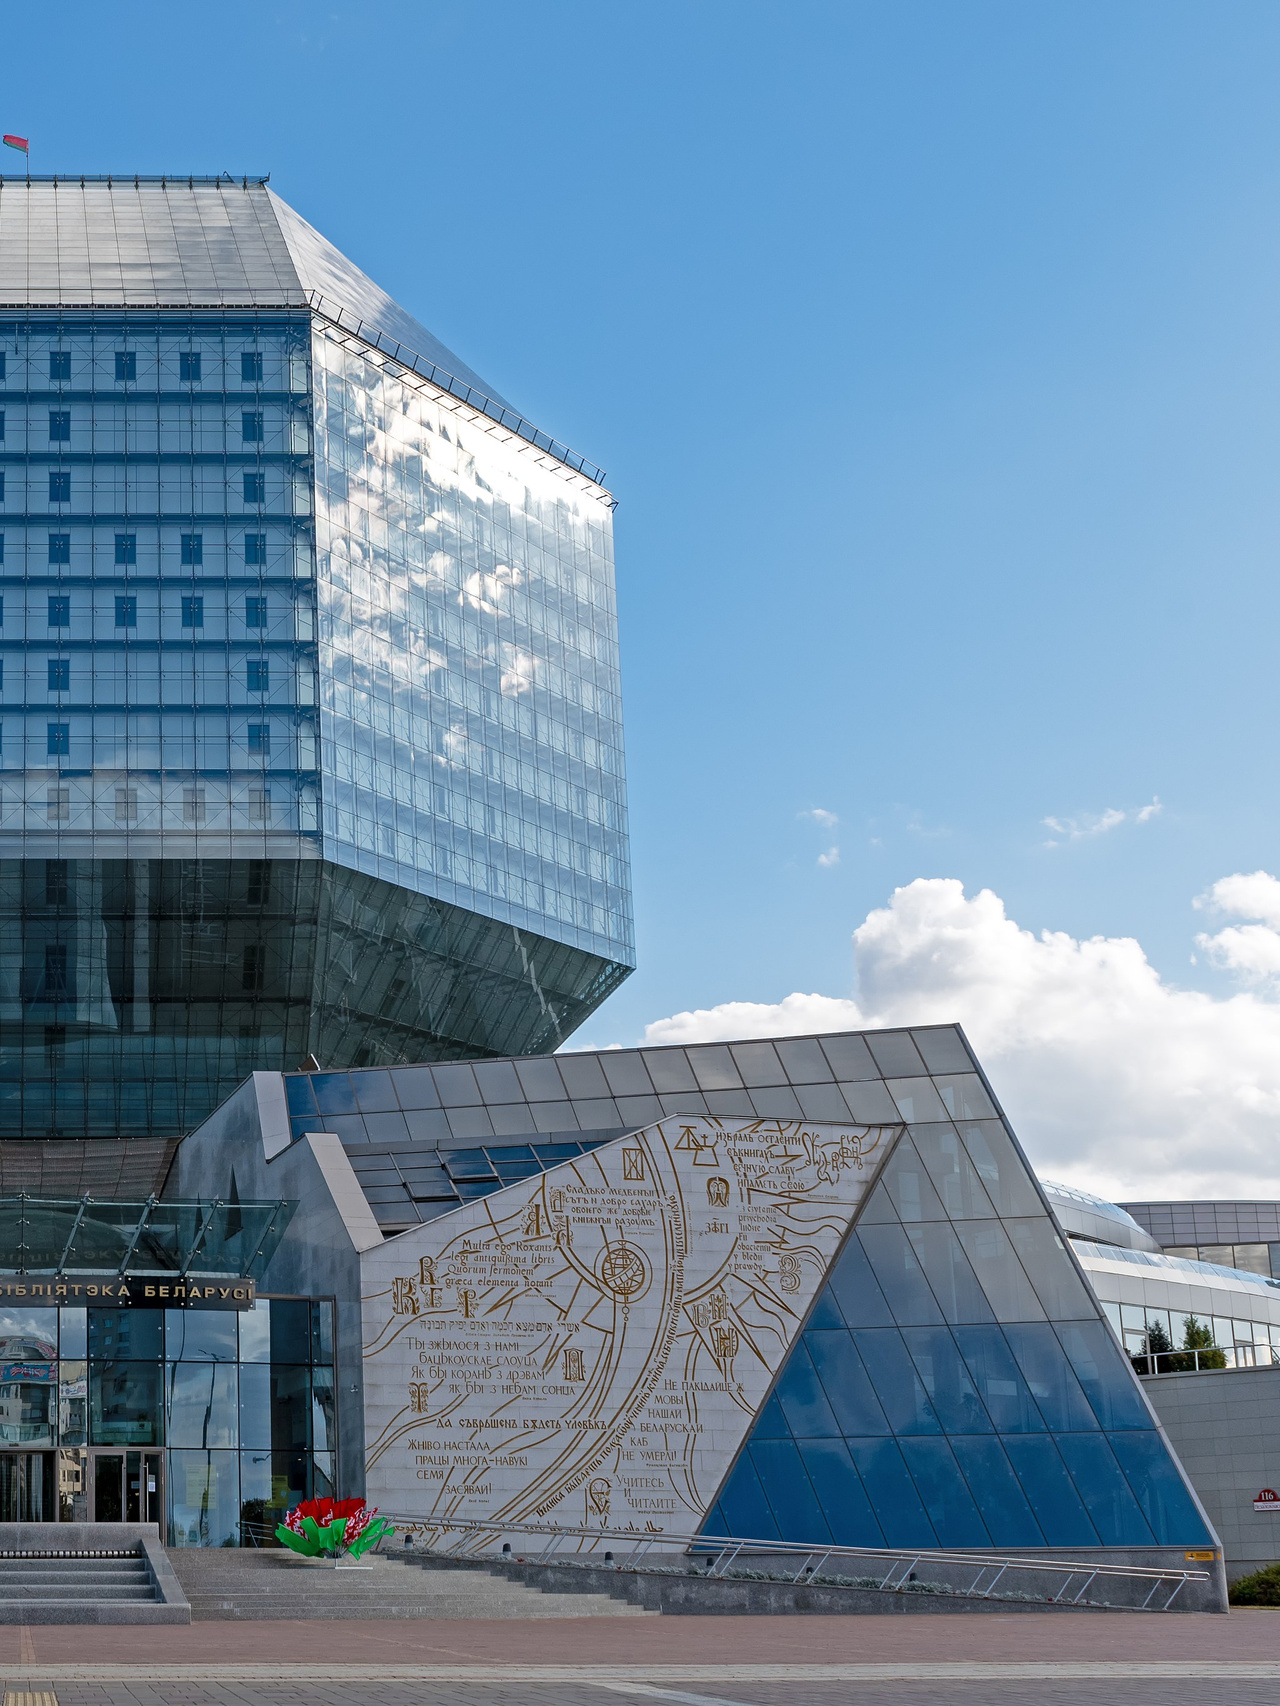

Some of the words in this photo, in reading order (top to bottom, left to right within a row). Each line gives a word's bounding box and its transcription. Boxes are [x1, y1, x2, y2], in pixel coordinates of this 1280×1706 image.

[462, 1239, 491, 1250] Multa
[495, 1242, 512, 1255] ego
[516, 1241, 553, 1252] Roxanis
[451, 1251, 469, 1265] legi
[531, 1253, 555, 1264] libris
[447, 1263, 487, 1275] Quorum
[478, 1276, 519, 1287] elementa
[524, 1278, 553, 1288] notant
[144, 1285, 253, 1300] БЕЛАРУСІ
[494, 1341, 520, 1351] НАМІ
[541, 1385, 576, 1396] СОНЦА
[664, 1379, 678, 1391] НЕ
[654, 1395, 684, 1405] МОВЫ
[407, 1439, 441, 1450] ЖНІВО
[444, 1441, 490, 1451] НАСТАЛА
[630, 1436, 648, 1447] КАБ
[415, 1455, 450, 1467] ПРАЦЫ
[622, 1451, 635, 1461] НЕ
[416, 1469, 444, 1480] СЕМЯ
[615, 1474, 665, 1488] УЧИТЕСЬ
[624, 1488, 631, 1498] И
[1261, 1491, 1274, 1501] 116
